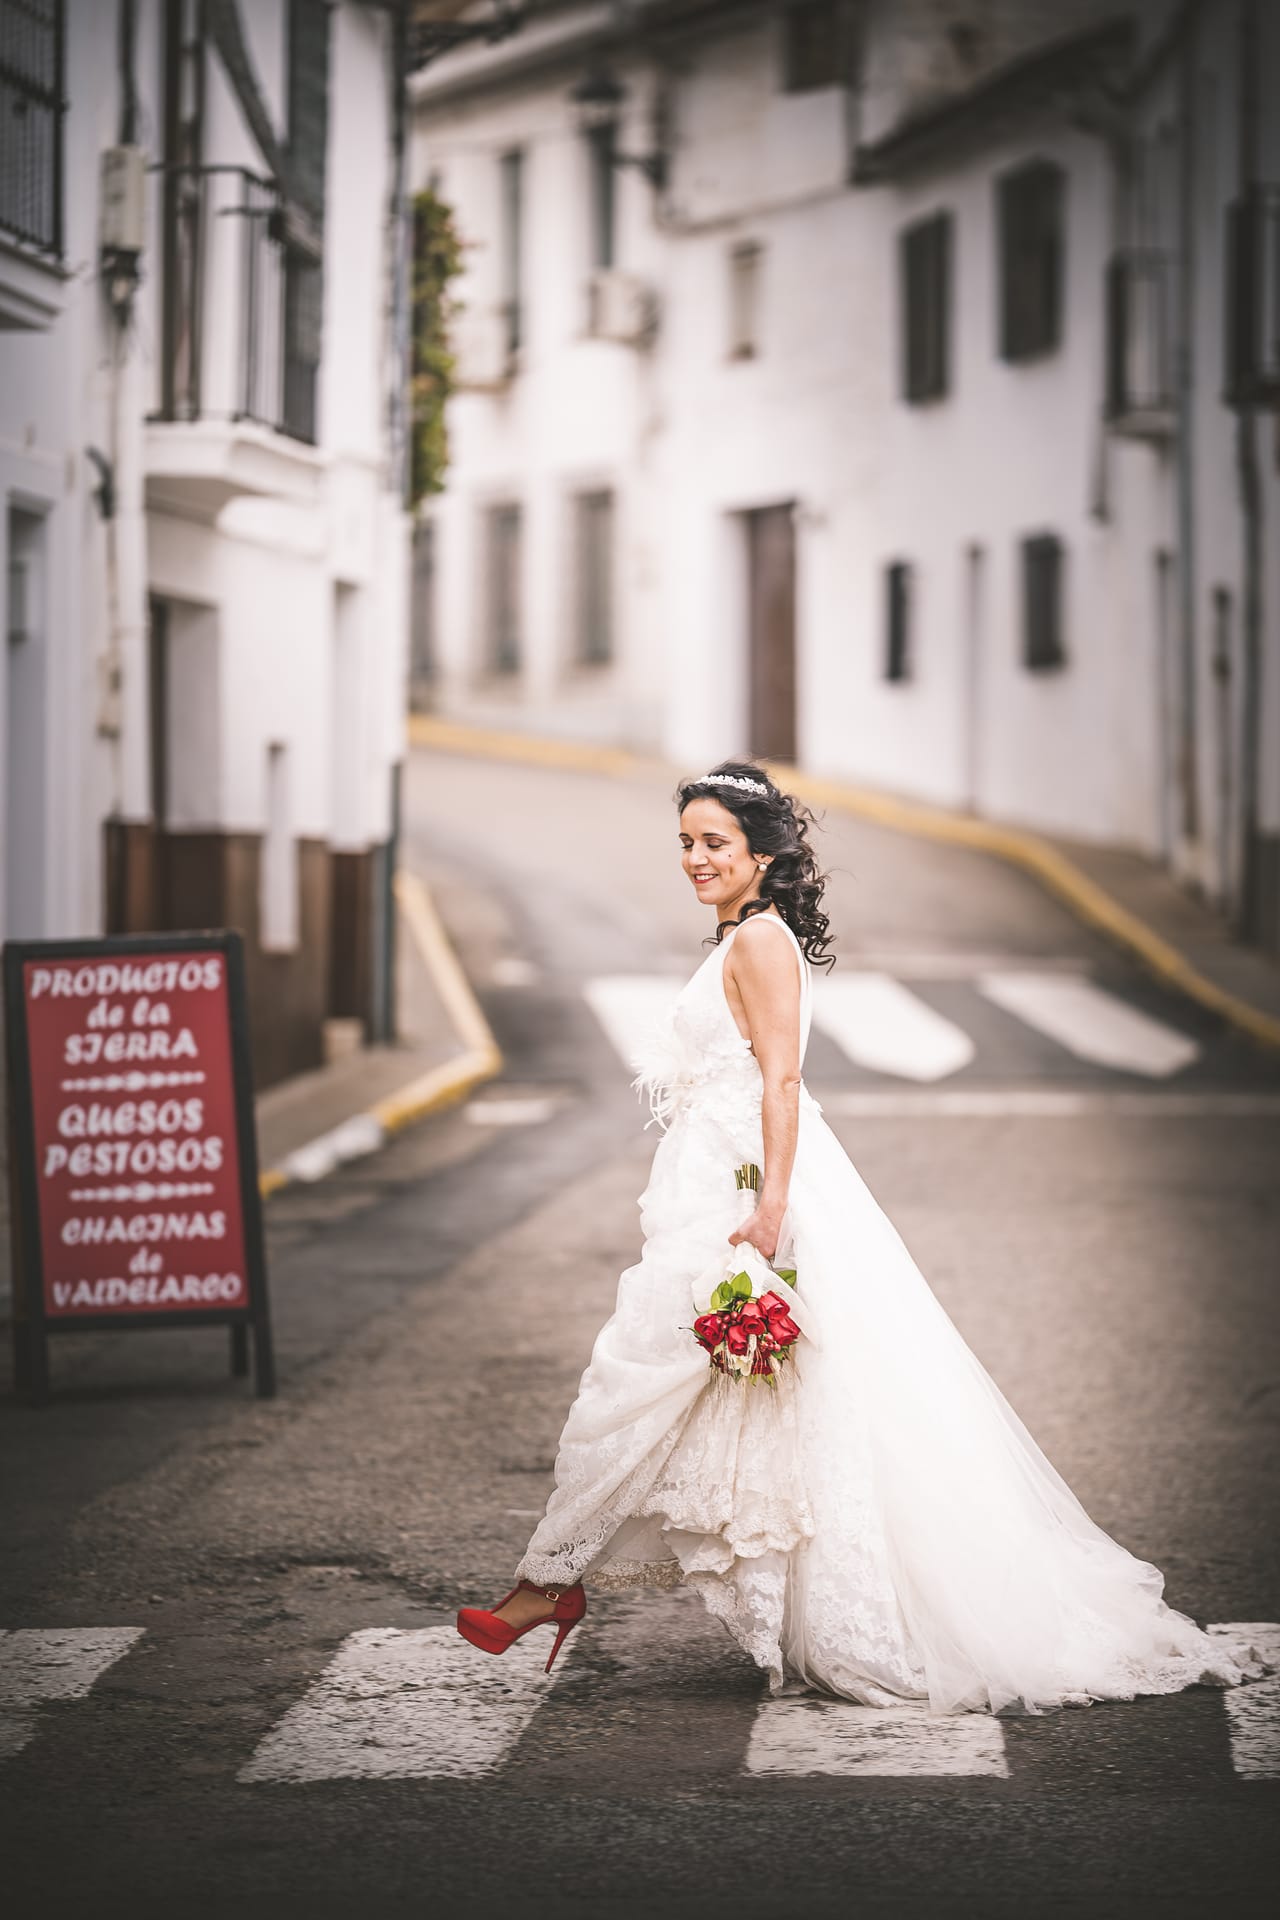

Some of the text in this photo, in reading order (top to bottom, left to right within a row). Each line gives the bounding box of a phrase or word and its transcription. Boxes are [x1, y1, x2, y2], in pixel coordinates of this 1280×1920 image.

[31, 959, 221, 998] PRODUCTOS
[87, 997, 171, 1029] de la
[64, 1028, 198, 1065] SIERRA
[58, 1098, 204, 1138] QUESOS
[44, 1136, 223, 1176] PESTOSOS
[61, 1210, 226, 1245] CHACINAS
[129, 1247, 163, 1274] de
